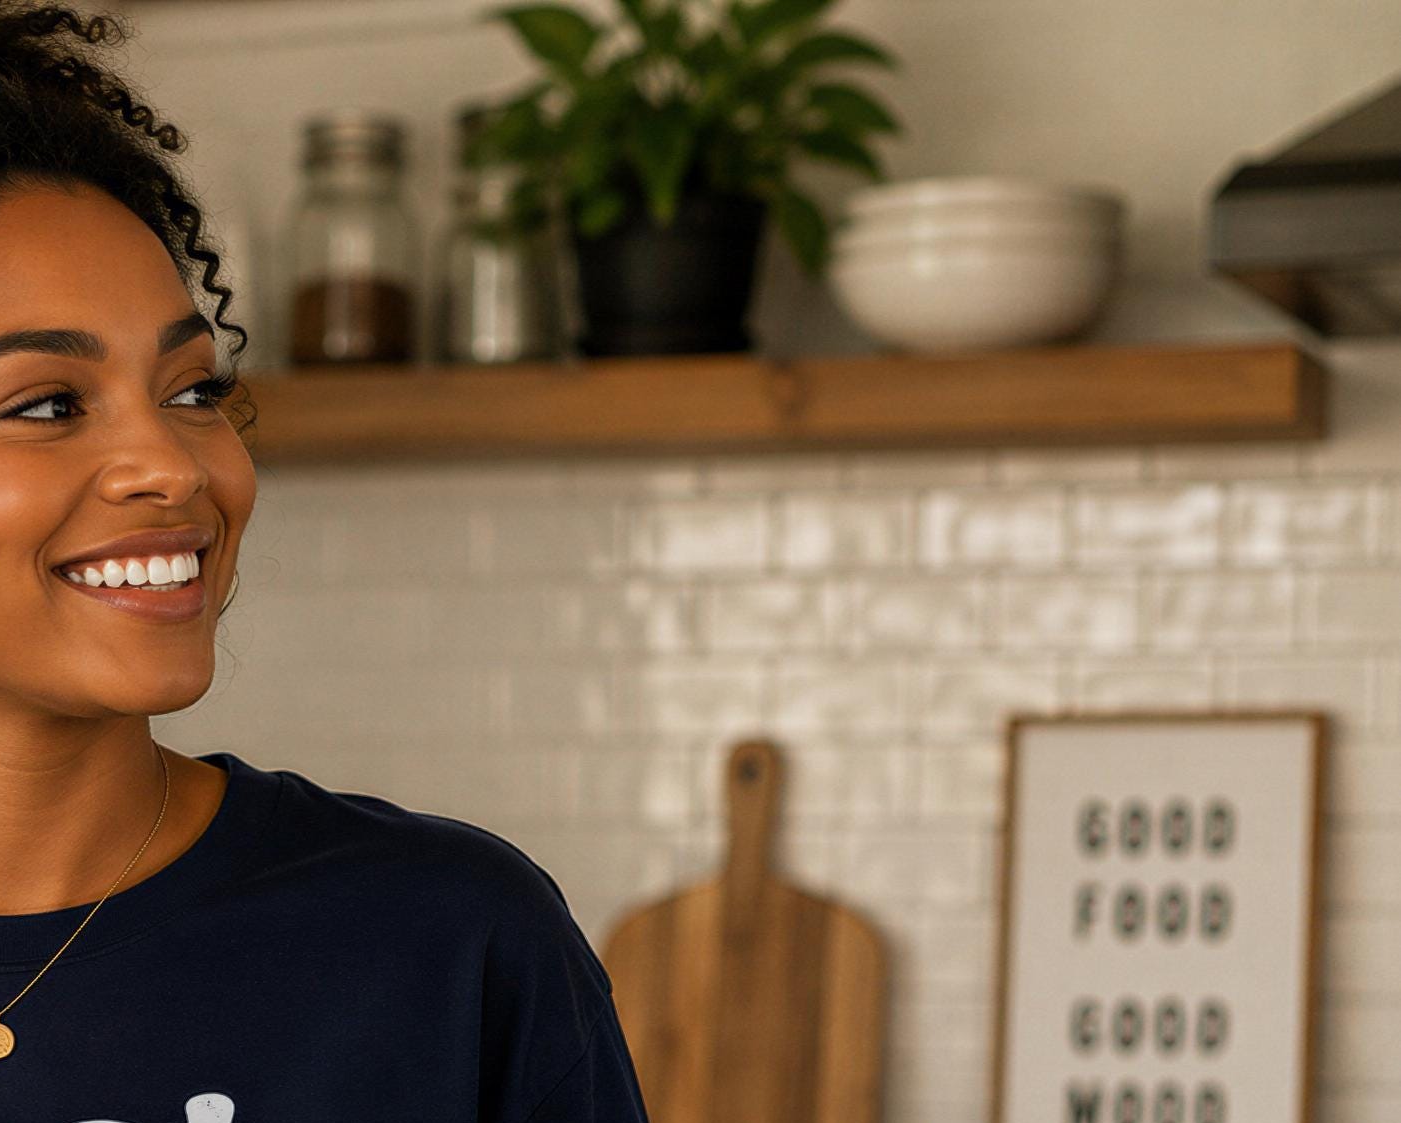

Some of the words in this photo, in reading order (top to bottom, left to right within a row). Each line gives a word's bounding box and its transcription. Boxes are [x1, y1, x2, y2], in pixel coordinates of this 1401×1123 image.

[1075, 799, 1236, 856] GOOD
[1073, 884, 1233, 943] FOOD
[1069, 999, 1230, 1056] GOOD
